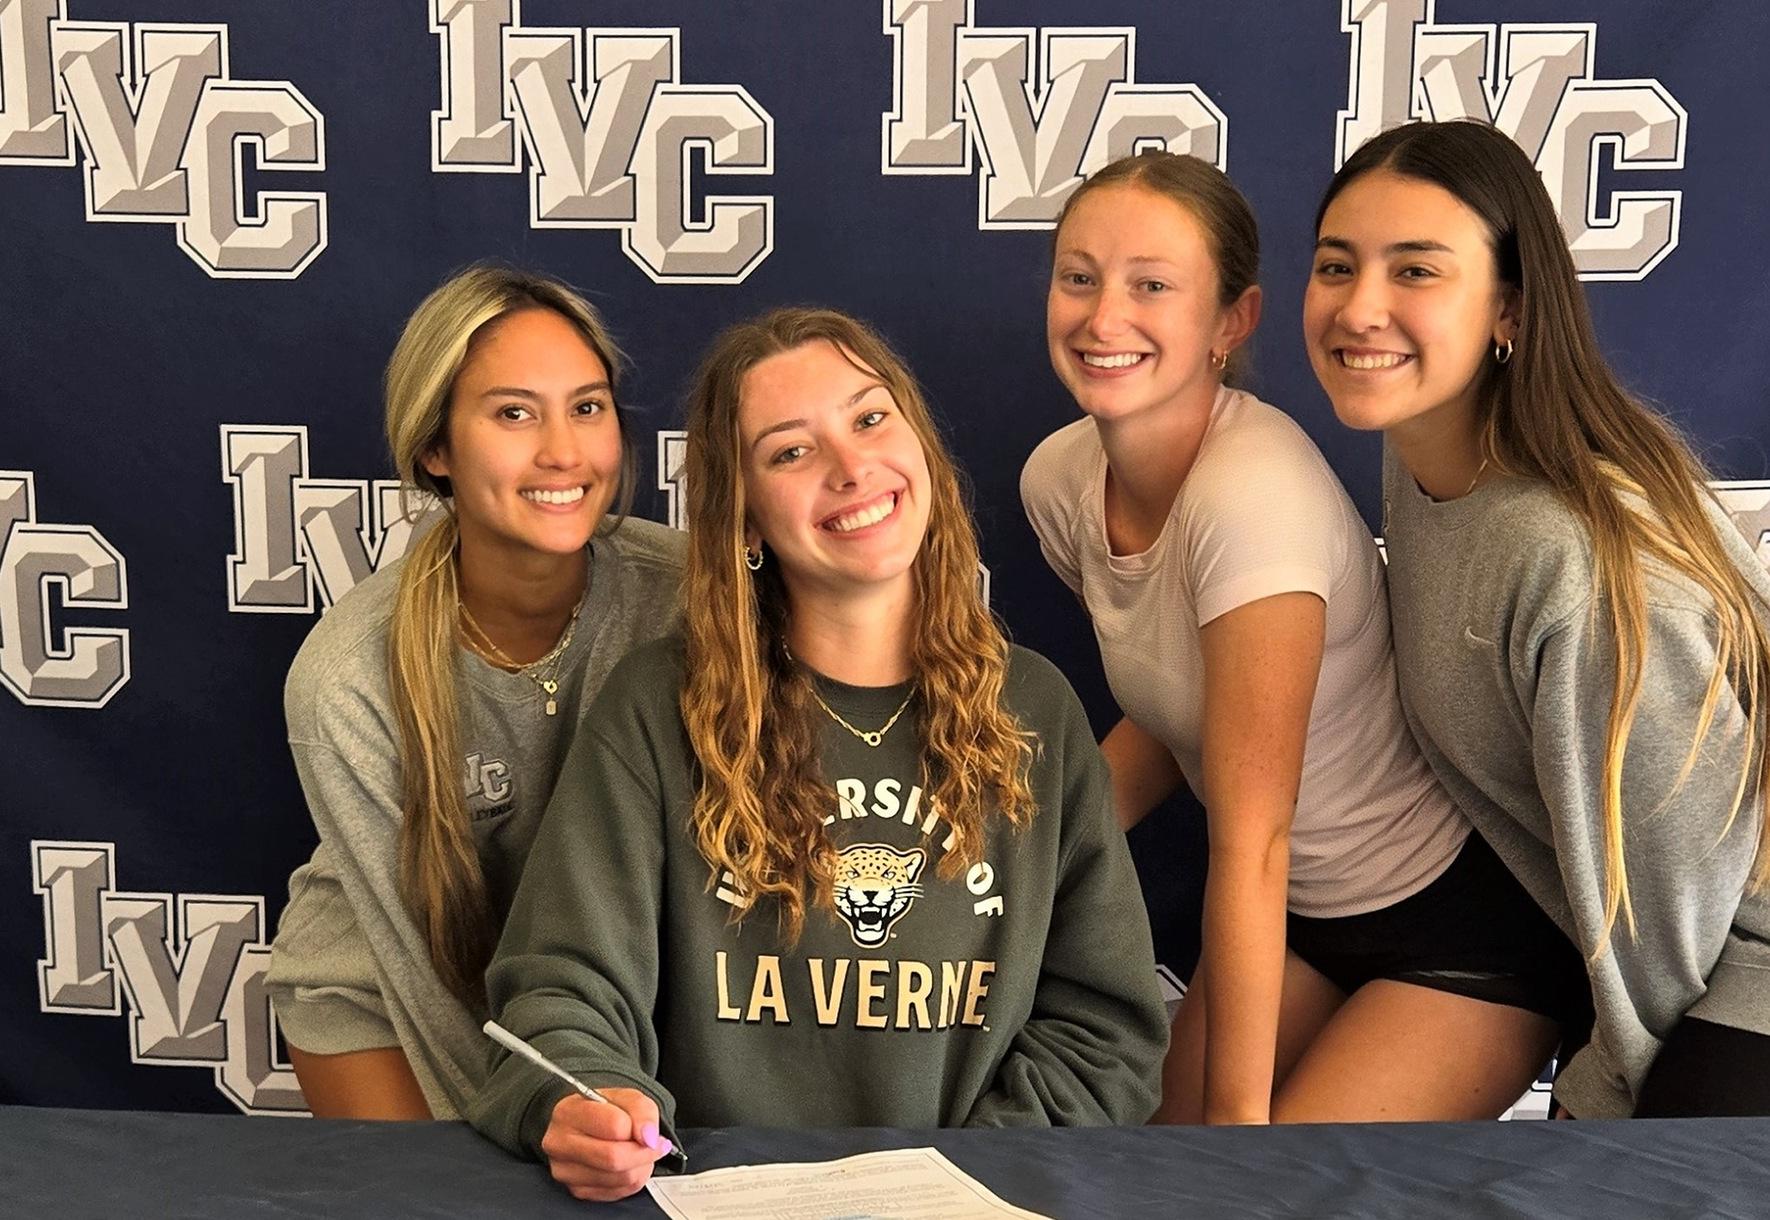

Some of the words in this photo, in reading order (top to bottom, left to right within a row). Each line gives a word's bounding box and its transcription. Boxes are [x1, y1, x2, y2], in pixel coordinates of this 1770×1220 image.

[0, 0, 327, 279] IVC
[429, 0, 774, 284] IVC
[965, 861, 1004, 918] OF
[716, 951, 791, 1023] LA
[807, 958, 996, 1030] VERNE
